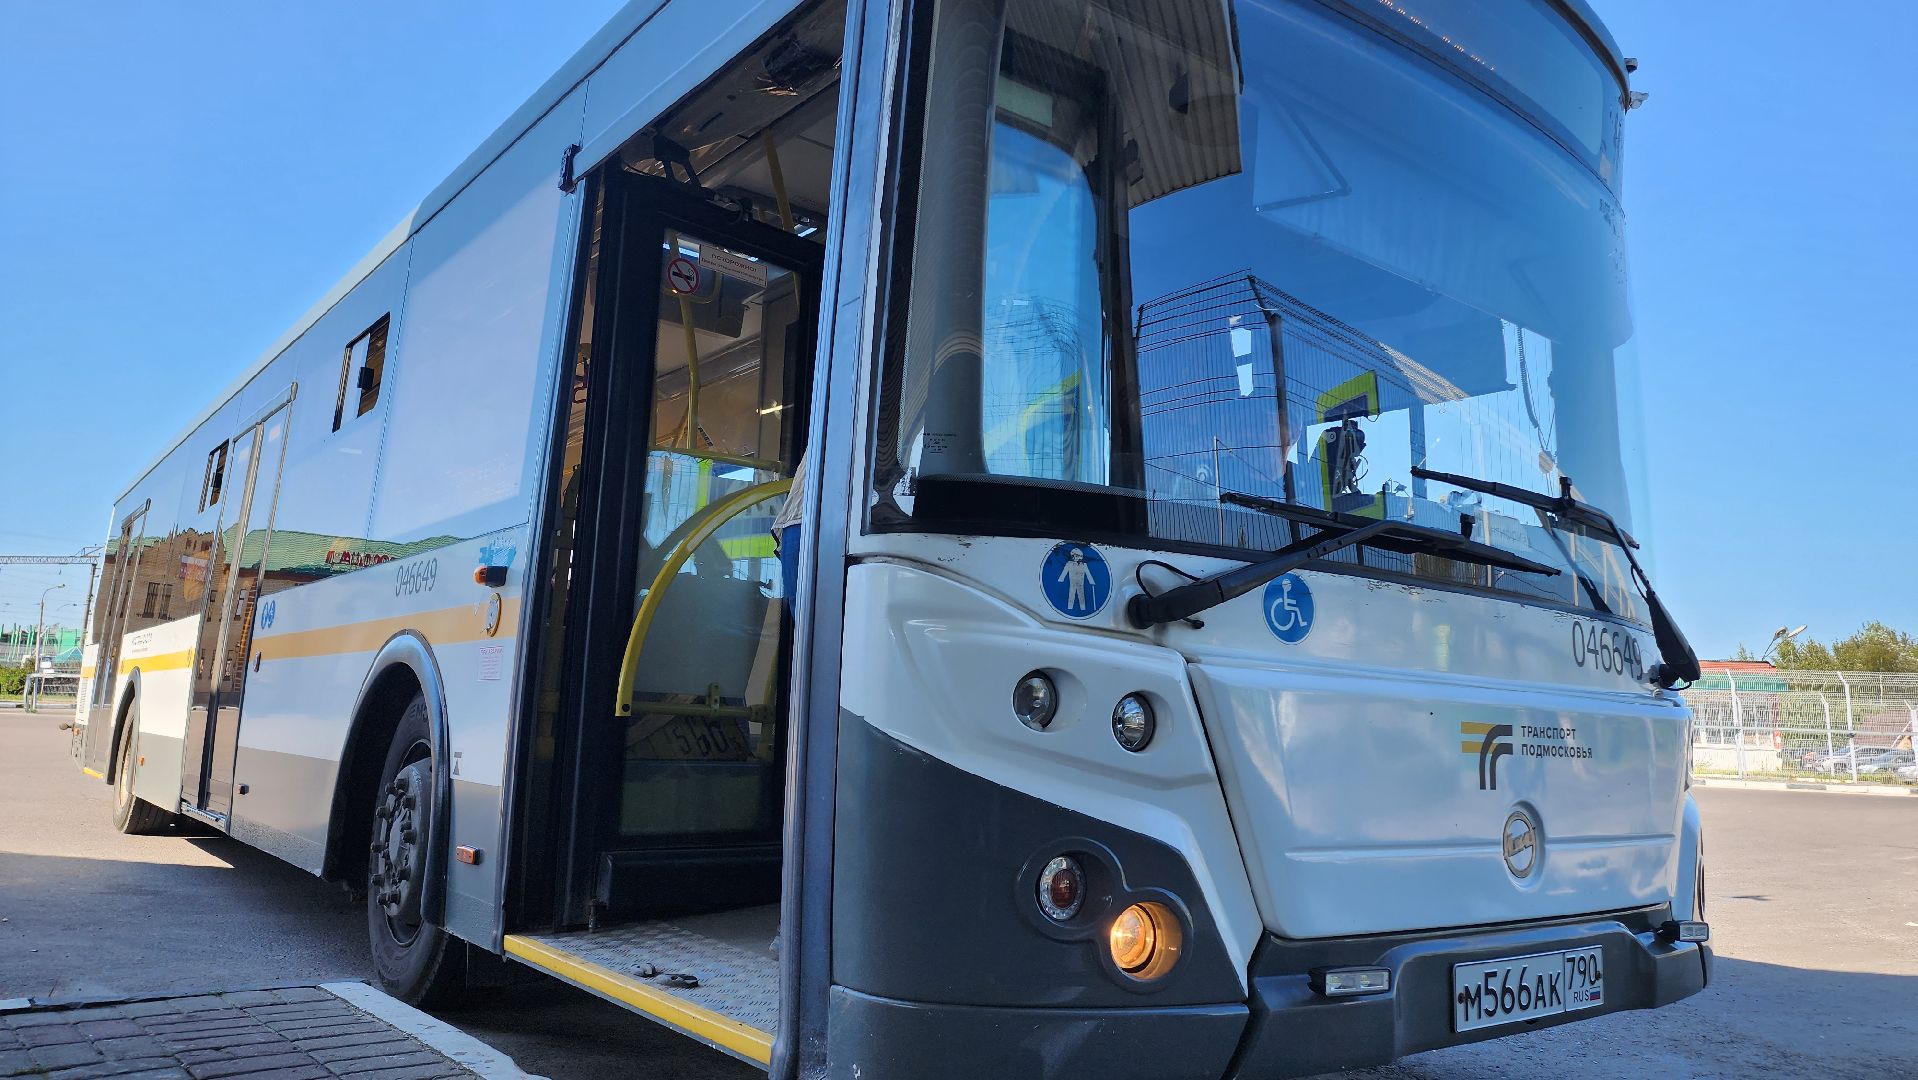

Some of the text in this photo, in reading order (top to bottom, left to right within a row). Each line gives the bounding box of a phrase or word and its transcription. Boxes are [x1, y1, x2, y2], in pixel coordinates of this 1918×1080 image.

[396, 558, 438, 597] 046649
[1572, 620, 1643, 680] 046649
[1521, 725, 1576, 740] ТРАНСПОРТ
[1521, 743, 1593, 759] ПОДМОСКОВЬЯ
[1567, 953, 1598, 990] 790
[1573, 989, 1589, 1003] RUS
